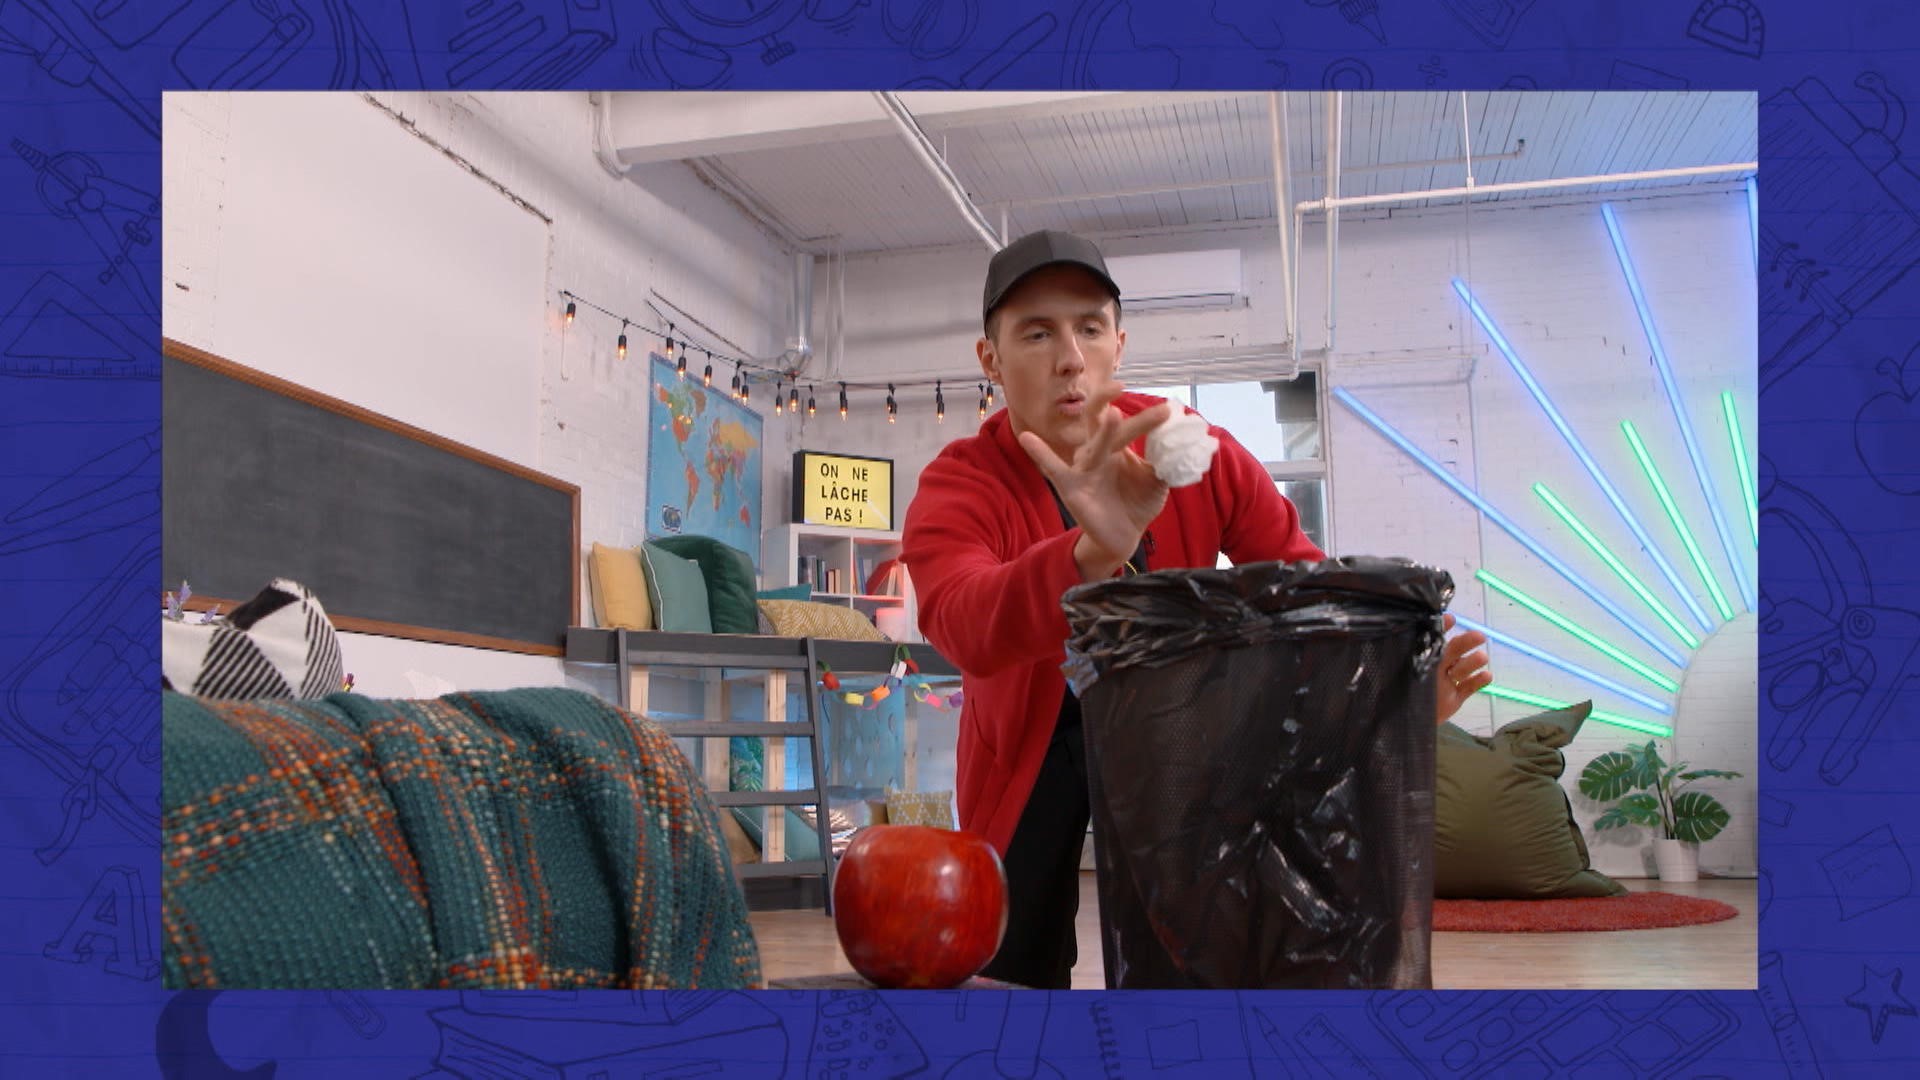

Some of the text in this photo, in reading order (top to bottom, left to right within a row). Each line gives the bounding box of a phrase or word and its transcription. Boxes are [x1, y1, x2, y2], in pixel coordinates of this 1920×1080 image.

[820, 463, 868, 482] ON NE
[821, 481, 868, 503] LÂCHE
